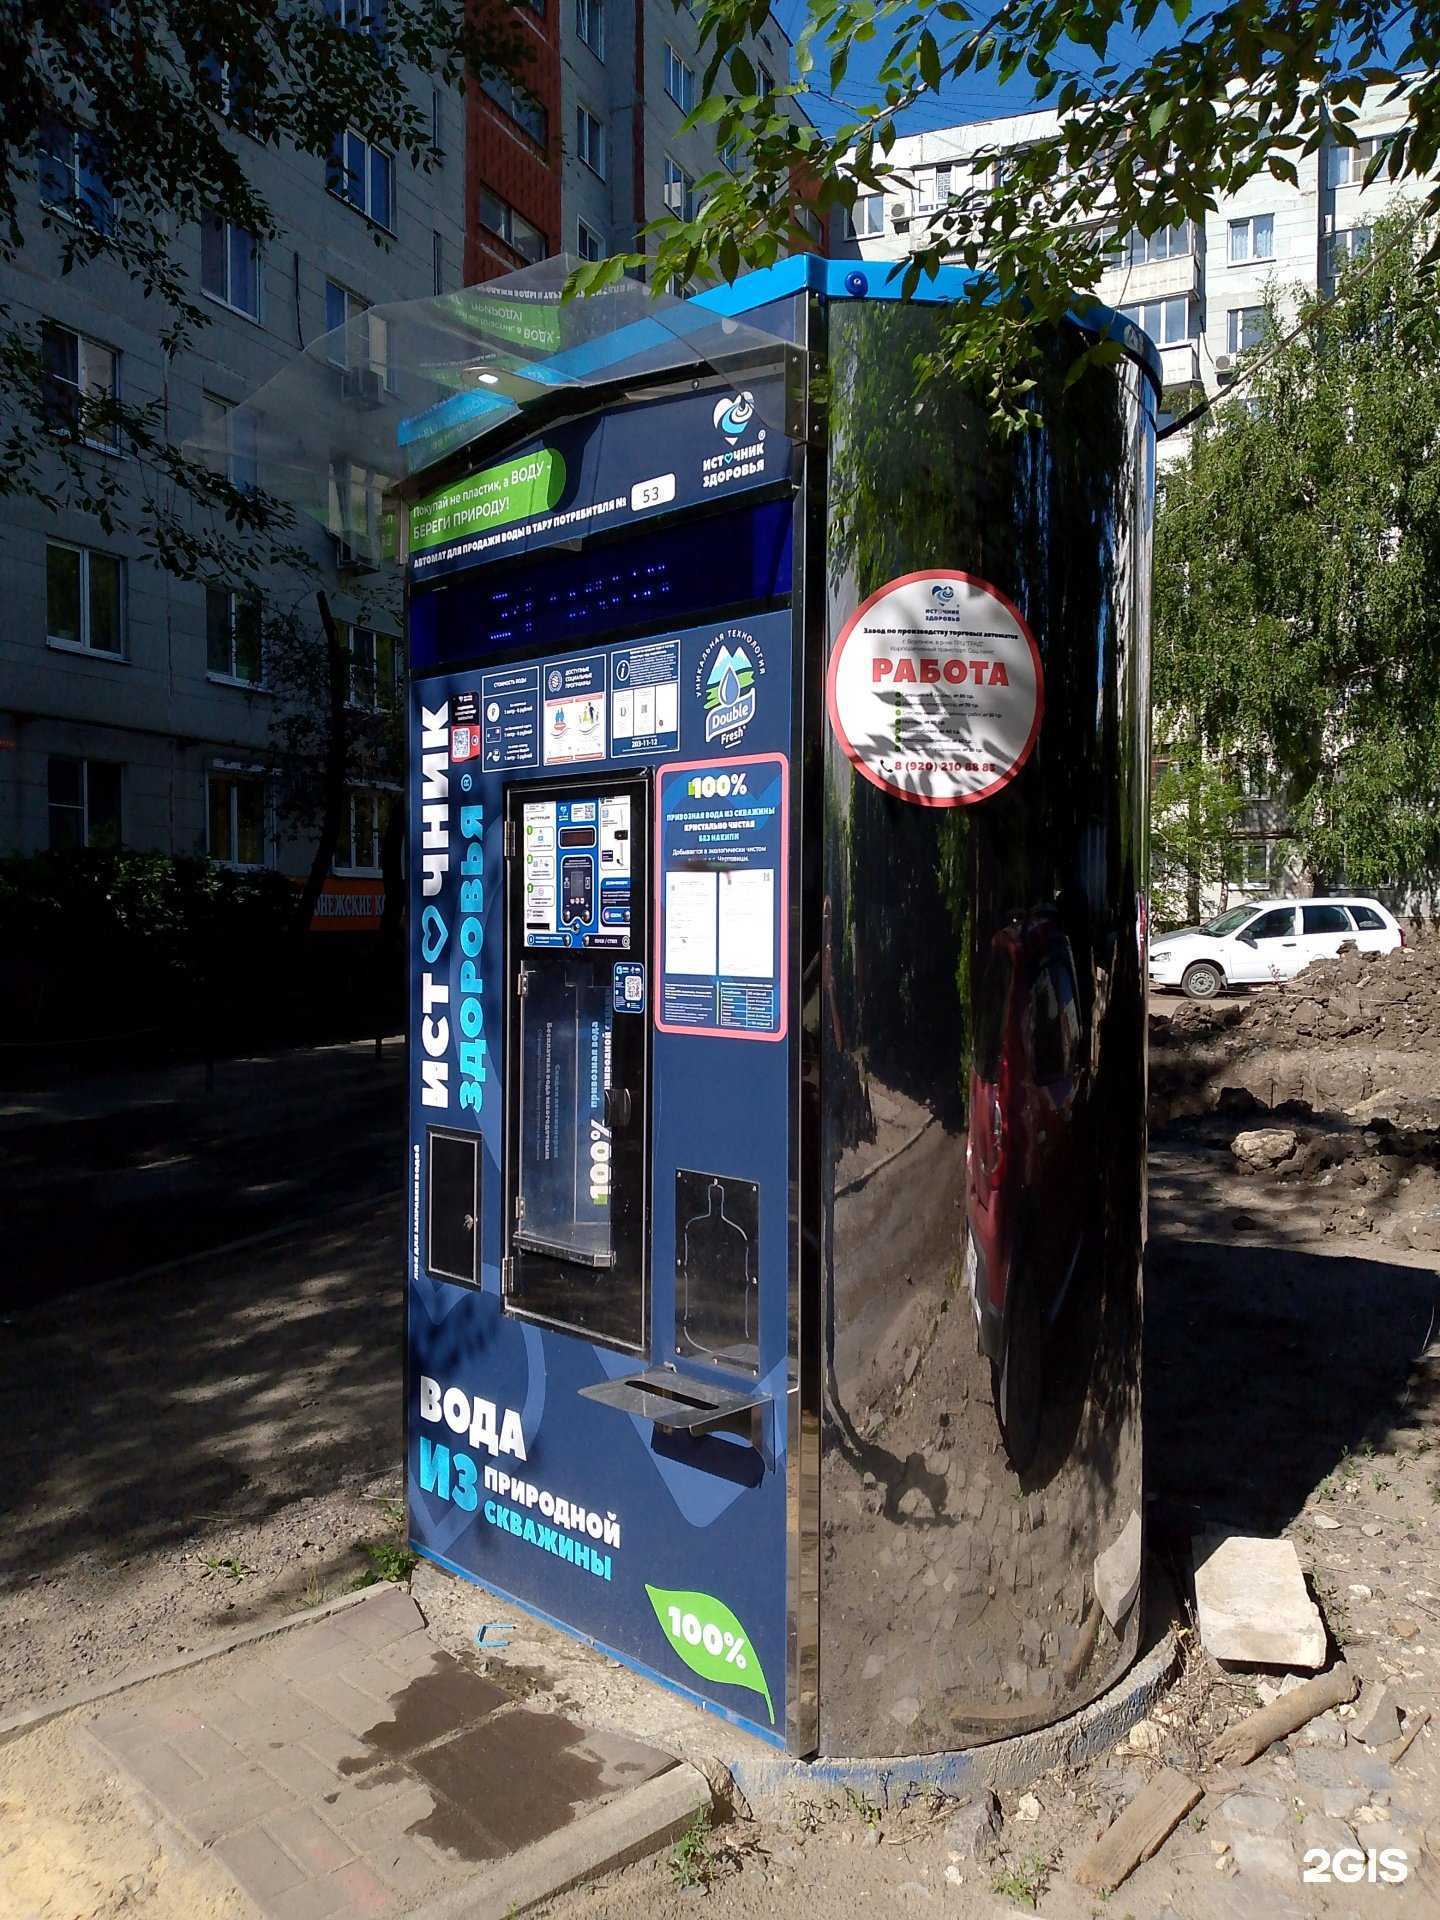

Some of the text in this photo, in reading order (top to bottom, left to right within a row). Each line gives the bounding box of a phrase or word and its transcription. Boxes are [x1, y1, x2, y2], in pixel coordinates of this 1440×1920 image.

[413, 495, 449, 518] Покупай
[450, 493, 461, 505] не
[462, 481, 502, 503] пластик,
[511, 461, 544, 487] ВОДУ
[702, 460, 765, 488] ЗДОРОВЬЯ
[413, 498, 510, 541] БЕРЕГИ ПРИРОДУ!
[414, 550, 448, 568] АВТОМАТ
[447, 545, 462, 560] ДЛЯ
[462, 536, 500, 557] ПРОДАЖИ
[501, 528, 525, 547] ВОДЫ
[532, 519, 552, 537] ТАРУ
[553, 501, 614, 530] ПОТРЕБИТЕЛЯ
[643, 486, 659, 503] 53
[696, 632, 726, 698] УНИКАЛЬНАЯ
[727, 629, 766, 675] ТЕХНОЛОГИЯ
[872, 657, 1010, 686] РАБОТА
[712, 703, 749, 729] Double
[721, 727, 744, 744] Fresh
[691, 773, 748, 799] 100%
[895, 761, 902, 770] 8
[905, 761, 938, 772] (920)
[941, 762, 962, 771] 210
[460, 804, 487, 1113] ЗДОРОВЬЯ
[590, 1118, 612, 1204] 100%
[420, 1375, 527, 1462] ВОДА
[419, 1435, 478, 1513] ИЗ
[484, 1465, 621, 1549] ПРИРОДНОЙ
[484, 1499, 612, 1582] СКВАЖИНЫ
[668, 1605, 747, 1670] 100%
